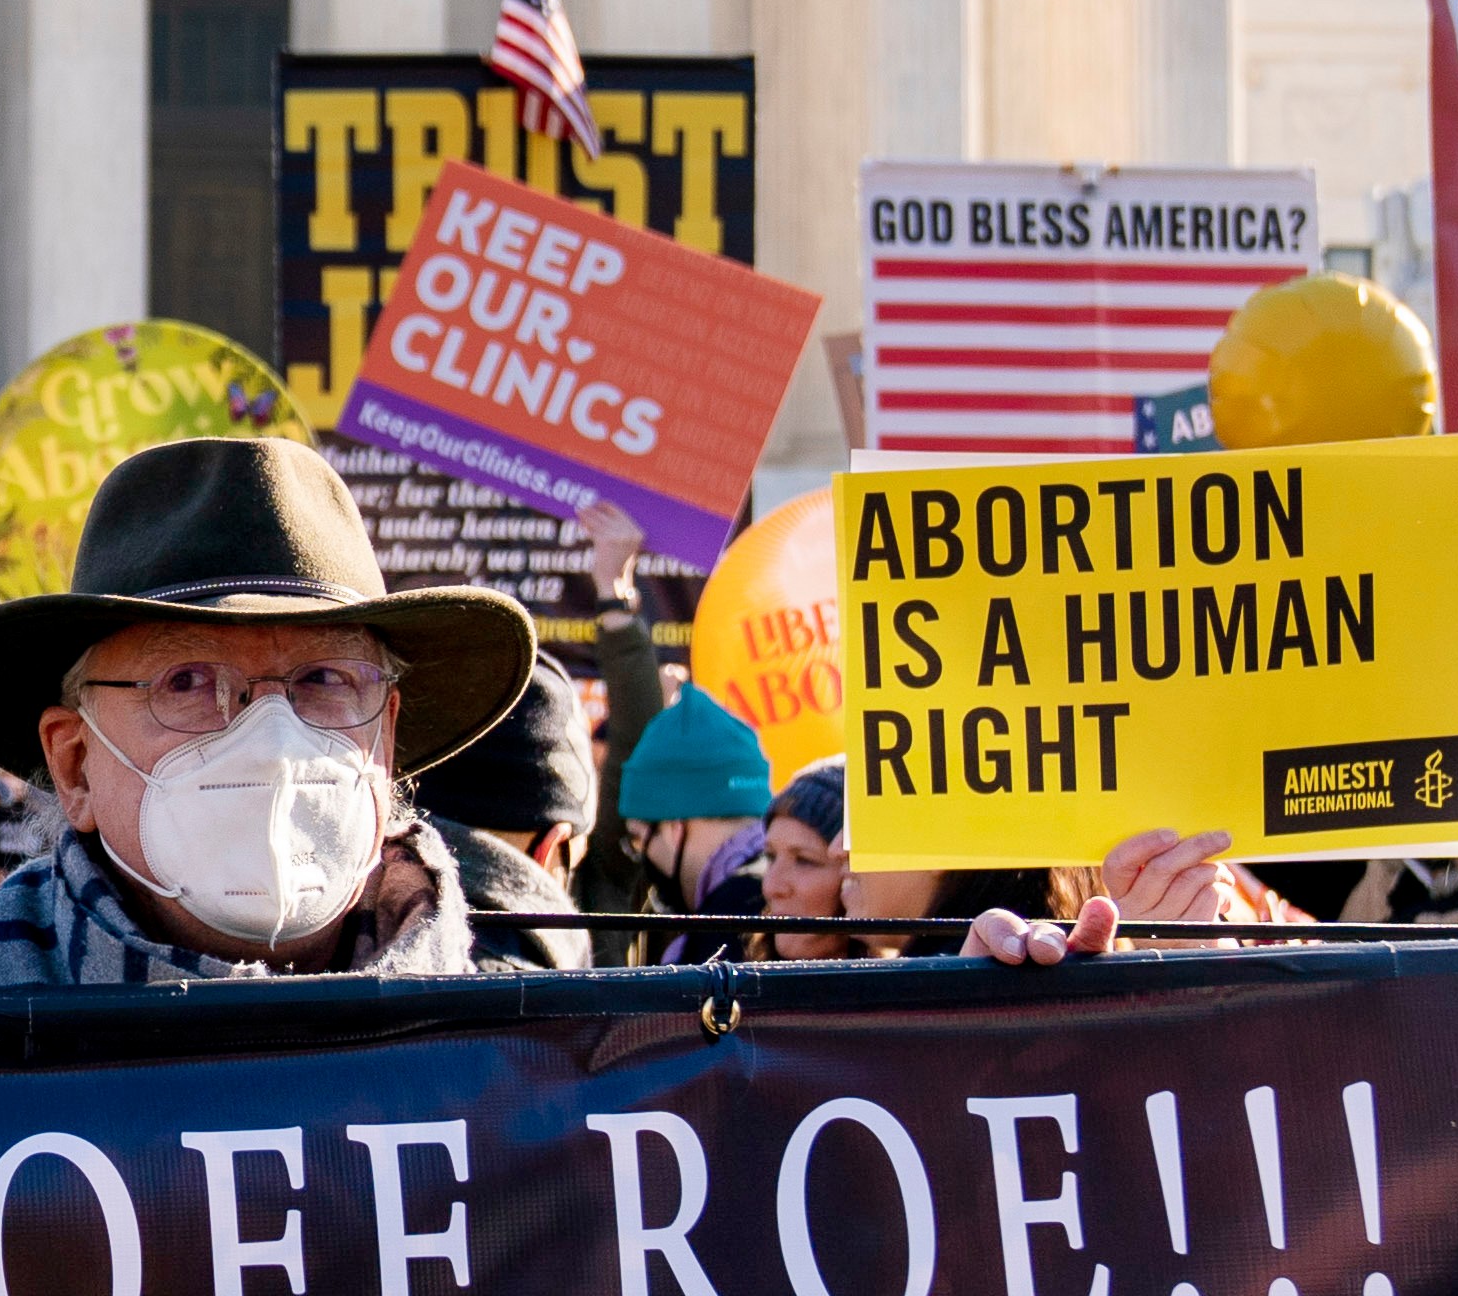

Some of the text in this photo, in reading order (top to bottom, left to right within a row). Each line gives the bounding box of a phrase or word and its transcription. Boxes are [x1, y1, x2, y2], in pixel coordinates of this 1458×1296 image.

[436, 189, 626, 296] KEEP
[871, 198, 1309, 254] GOD BLESS AMERICA?
[415, 253, 571, 354] OUR
[40, 360, 235, 443] Grow
[390, 314, 664, 455] CLINICS
[378, 511, 460, 541] under
[460, 510, 557, 541] heaven
[486, 549, 528, 572] we
[852, 466, 1305, 584] ABORTION
[863, 573, 1377, 691] IS A HUMAN
[865, 702, 1131, 798] RIGHT
[1284, 758, 1395, 795] AMNESTY
[1284, 788, 1395, 817] INTERNATIONAL
